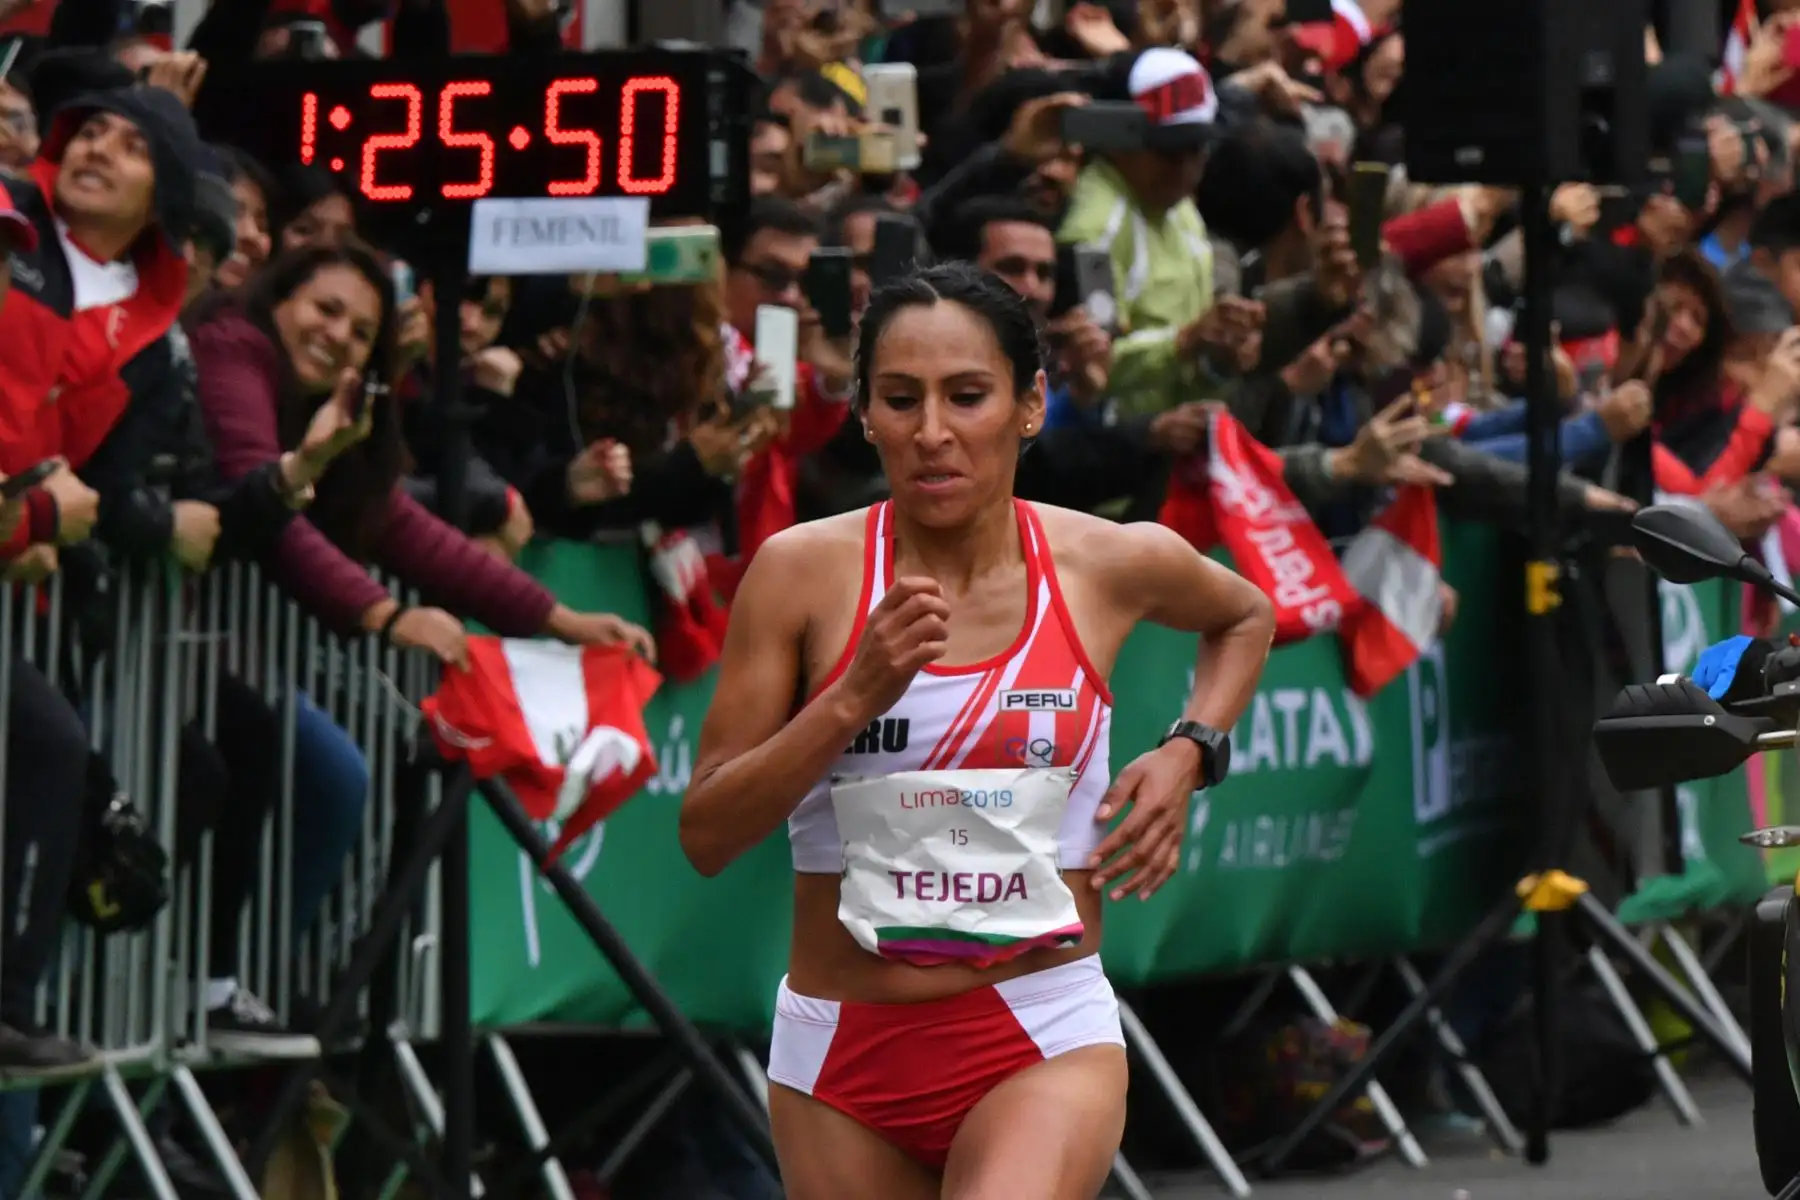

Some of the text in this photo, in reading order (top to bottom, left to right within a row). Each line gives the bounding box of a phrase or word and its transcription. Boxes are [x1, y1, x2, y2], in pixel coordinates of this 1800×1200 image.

[492, 214, 626, 246] FEMENIL
[1006, 693, 1074, 708] PERU
[844, 718, 910, 754] RU
[949, 829, 968, 846] 15
[888, 870, 1029, 904] TEJEDA
